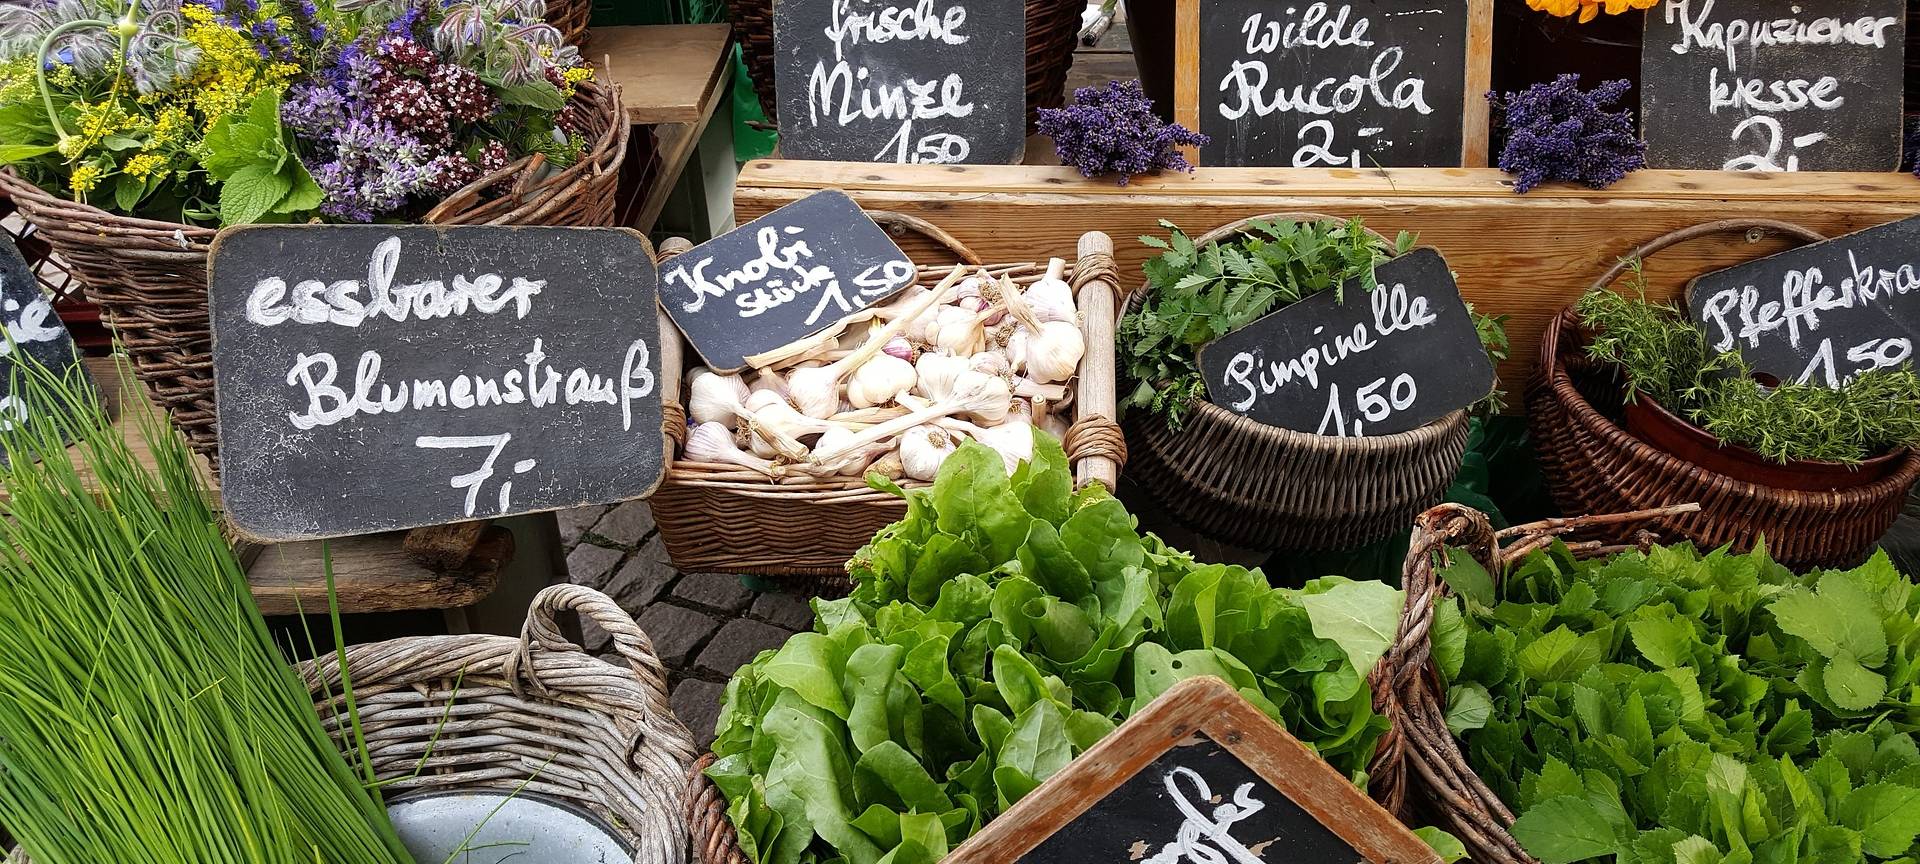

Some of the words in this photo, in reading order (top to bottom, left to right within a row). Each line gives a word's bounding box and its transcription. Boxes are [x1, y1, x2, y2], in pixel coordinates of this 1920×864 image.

[825, 0, 970, 61] frische
[1241, 1, 1374, 54] wilde
[809, 61, 973, 127] Minze
[1219, 46, 1435, 120] Rucola
[874, 119, 970, 164] 1,50
[246, 235, 547, 327] essbarer
[665, 226, 813, 313] Knobi
[804, 260, 914, 325] 1,50
[1224, 283, 1437, 411] Pimpinelle
[287, 338, 654, 431] Blumenstrauß
[1316, 373, 1417, 437] 1,50
